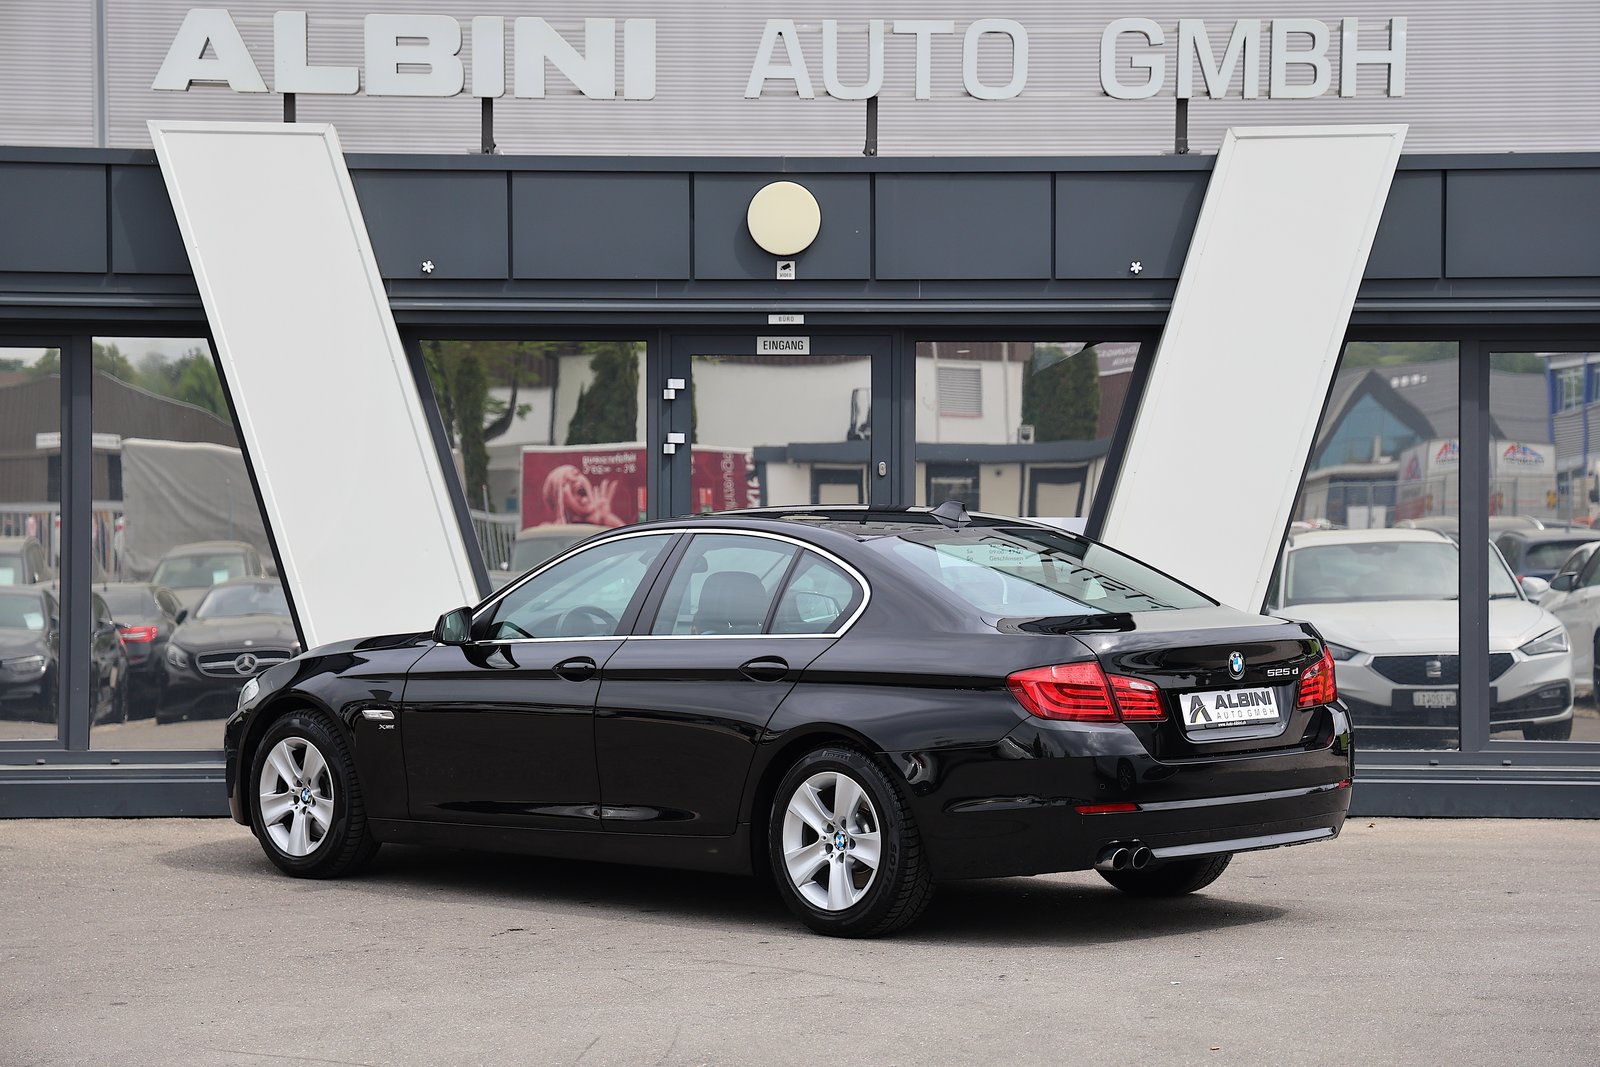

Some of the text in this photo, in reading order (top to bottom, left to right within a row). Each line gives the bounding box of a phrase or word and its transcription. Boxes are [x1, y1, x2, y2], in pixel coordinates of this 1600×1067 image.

[151, 8, 1408, 100] ALBINI AUTO GMBH
[763, 340, 804, 350] EINGANG
[1267, 667, 1299, 677] 525 d
[1215, 691, 1272, 709] ALBINI
[1216, 707, 1275, 720] AUTO GMBH
